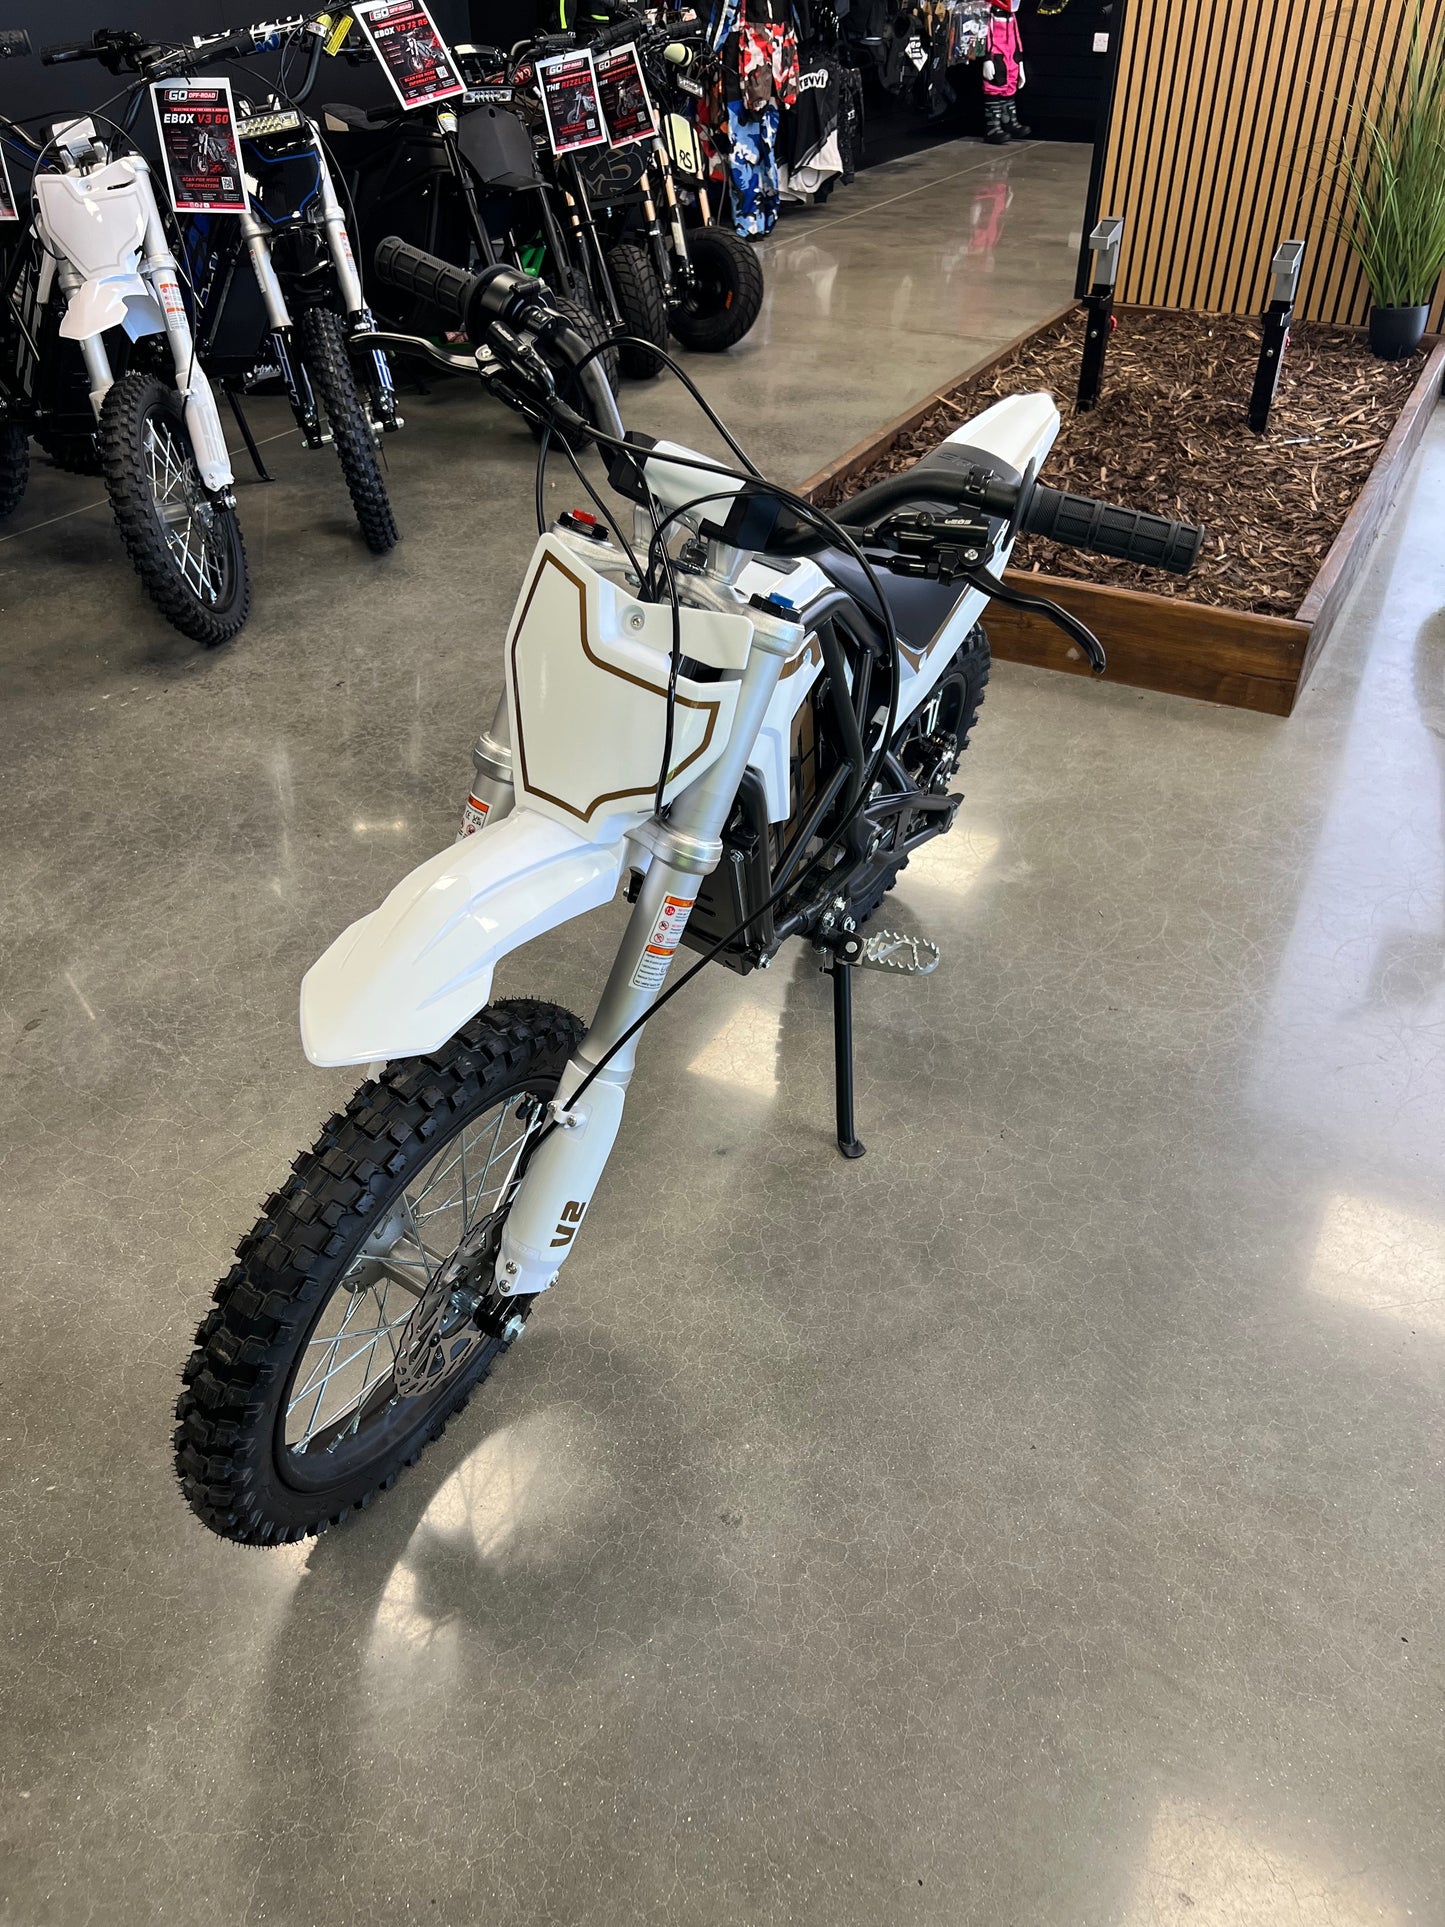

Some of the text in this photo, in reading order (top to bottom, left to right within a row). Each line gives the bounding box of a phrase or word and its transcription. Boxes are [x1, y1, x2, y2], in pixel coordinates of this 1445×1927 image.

[374, 7, 389, 19] GO
[374, 26, 395, 39] EBOX
[395, 24, 406, 32] V3
[407, 21, 417, 29] 72
[417, 18, 428, 26] RS
[549, 64, 563, 74] GO
[598, 60, 611, 71] GO
[546, 82, 560, 92] THE
[561, 76, 591, 88] RIZZLER
[169, 90, 188, 101] GO
[163, 113, 229, 125] EBOX V3 60
[549, 1200, 587, 1248] V2
